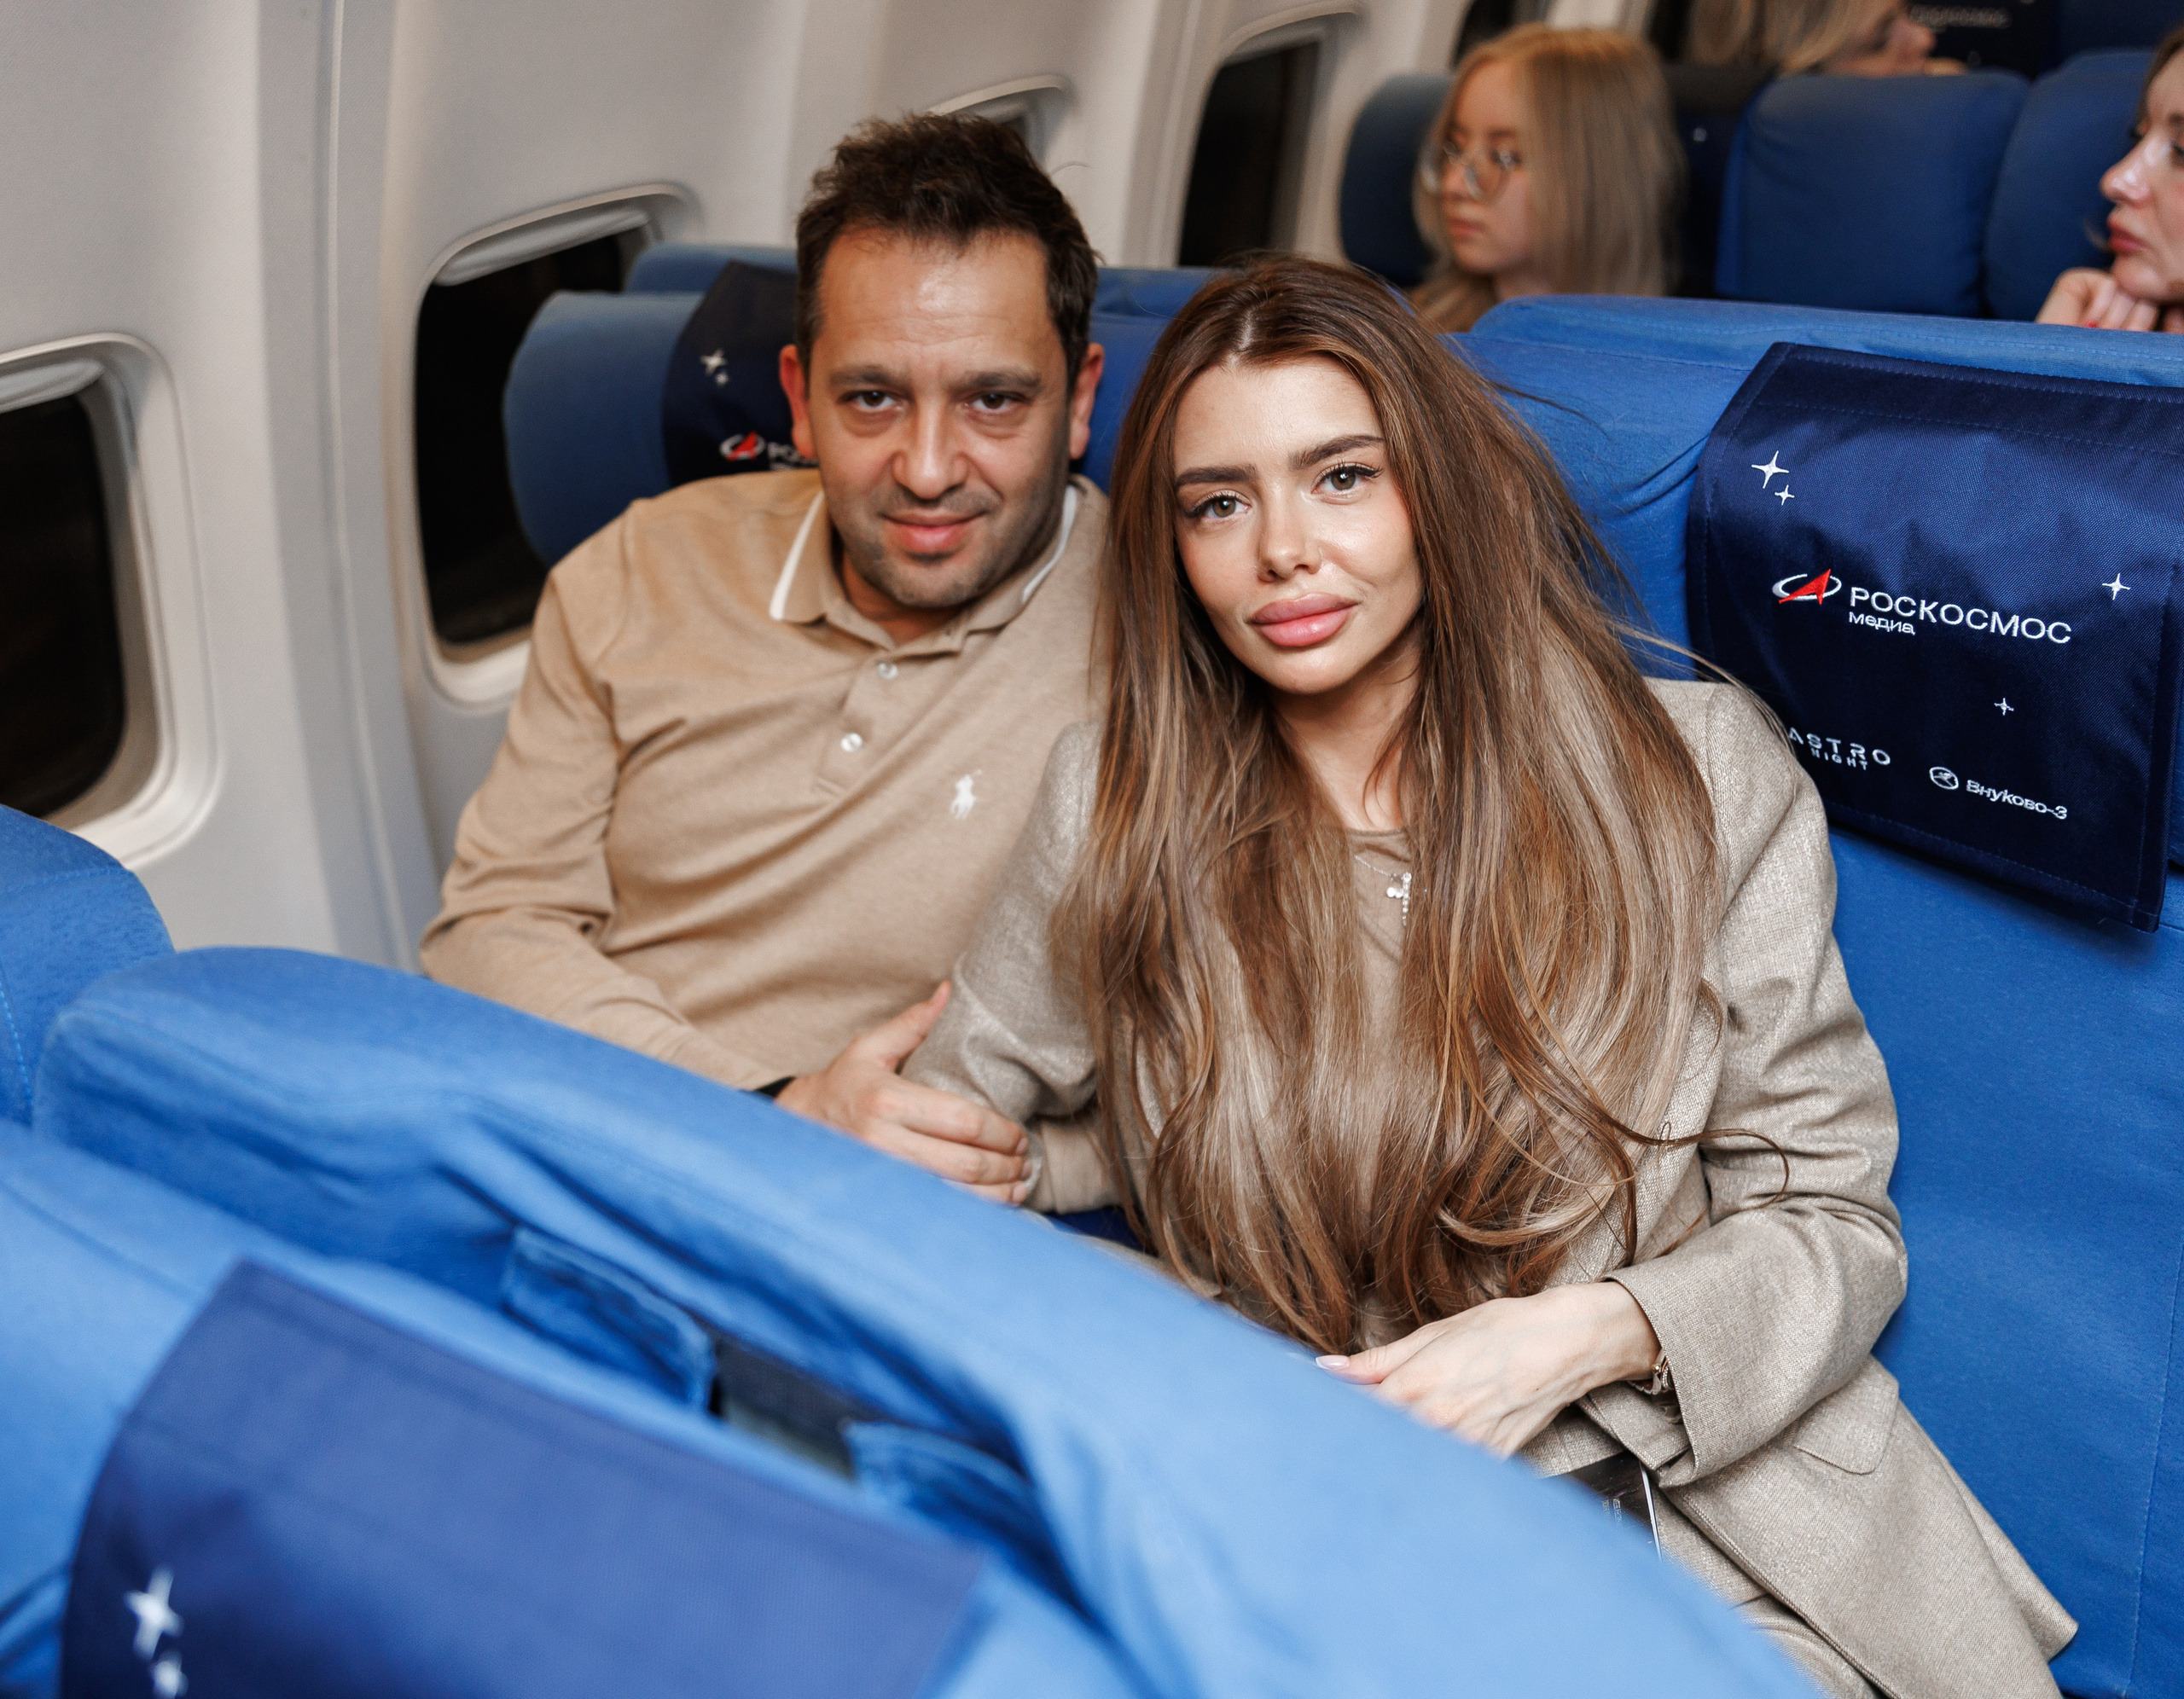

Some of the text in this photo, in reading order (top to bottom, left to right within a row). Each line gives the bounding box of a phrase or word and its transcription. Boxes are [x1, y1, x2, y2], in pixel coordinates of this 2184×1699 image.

[1848, 611, 1916, 635] медиа
[1850, 586, 2072, 644] РОСКОСМОС
[1788, 727, 1891, 766] ASTRO
[1810, 747, 1868, 771] NIGHT
[1965, 779, 2068, 820] Внуково-3
